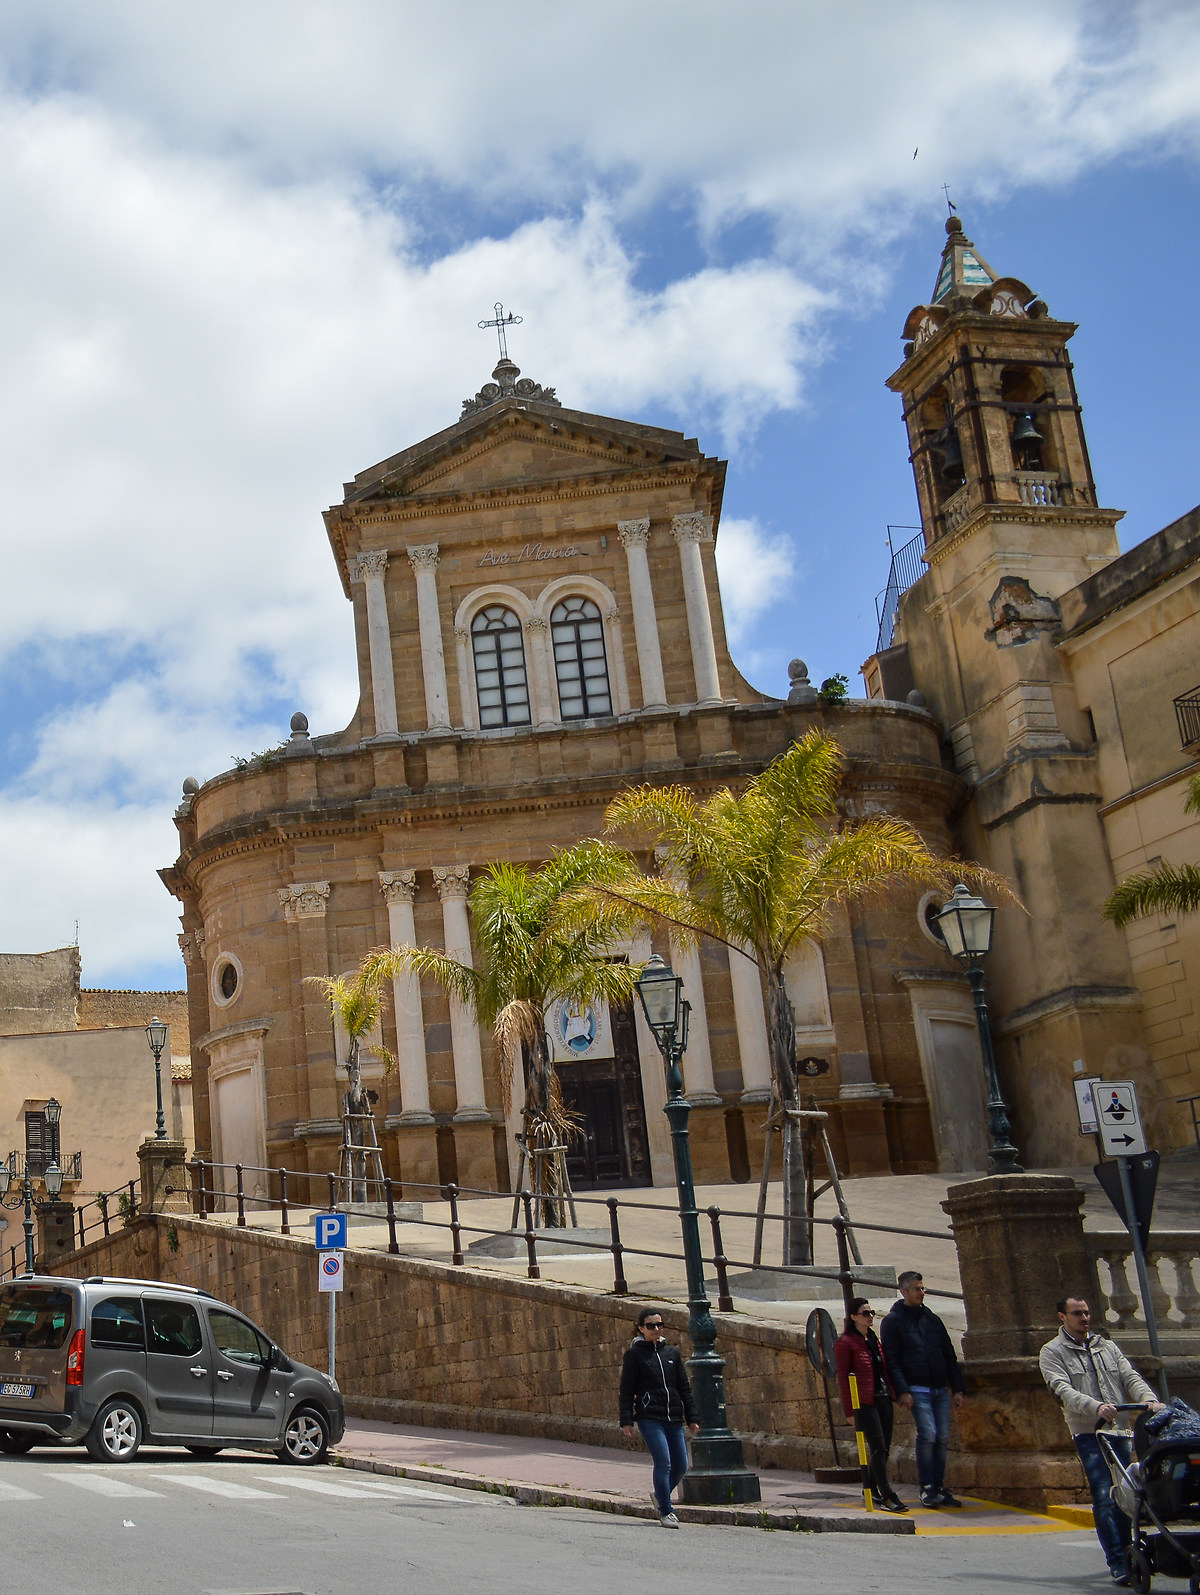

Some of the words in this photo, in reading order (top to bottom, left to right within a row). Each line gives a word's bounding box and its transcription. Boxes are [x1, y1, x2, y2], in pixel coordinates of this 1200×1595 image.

[479, 548, 509, 566] Ave
[518, 543, 576, 562] Maria
[321, 1218, 341, 1245] P
